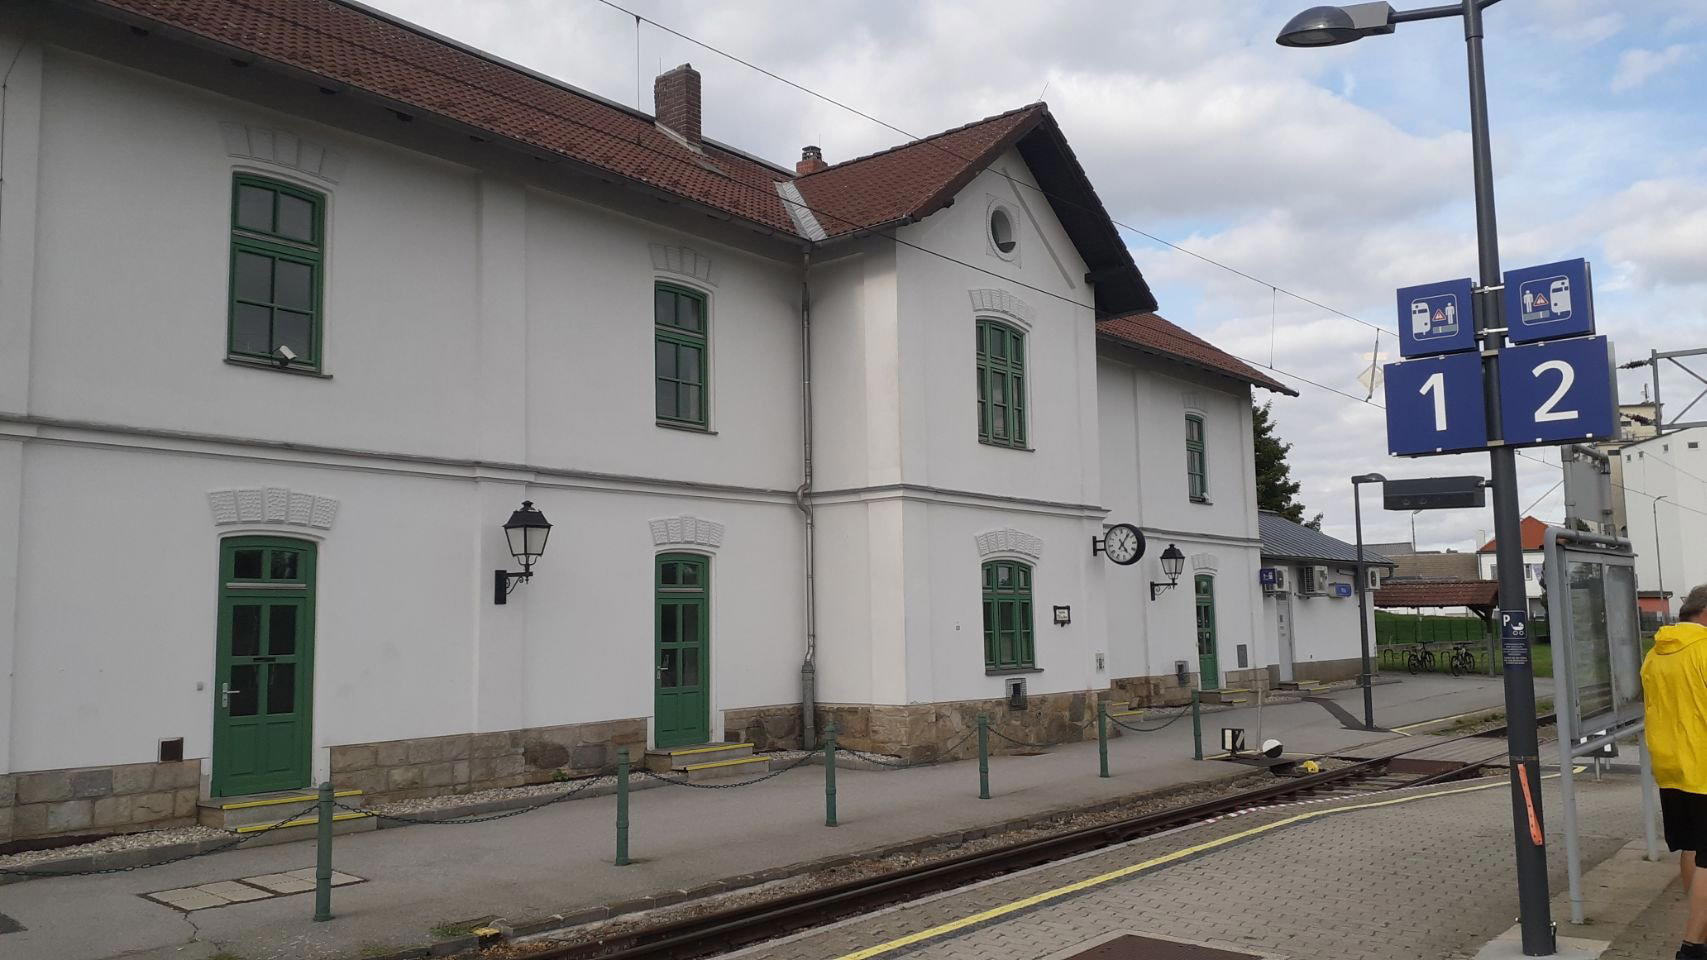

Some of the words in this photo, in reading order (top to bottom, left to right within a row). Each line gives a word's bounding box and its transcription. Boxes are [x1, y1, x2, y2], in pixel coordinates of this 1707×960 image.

[1419, 372, 1448, 432] 1
[1531, 359, 1579, 423] 2
[1503, 614, 1510, 626] P
